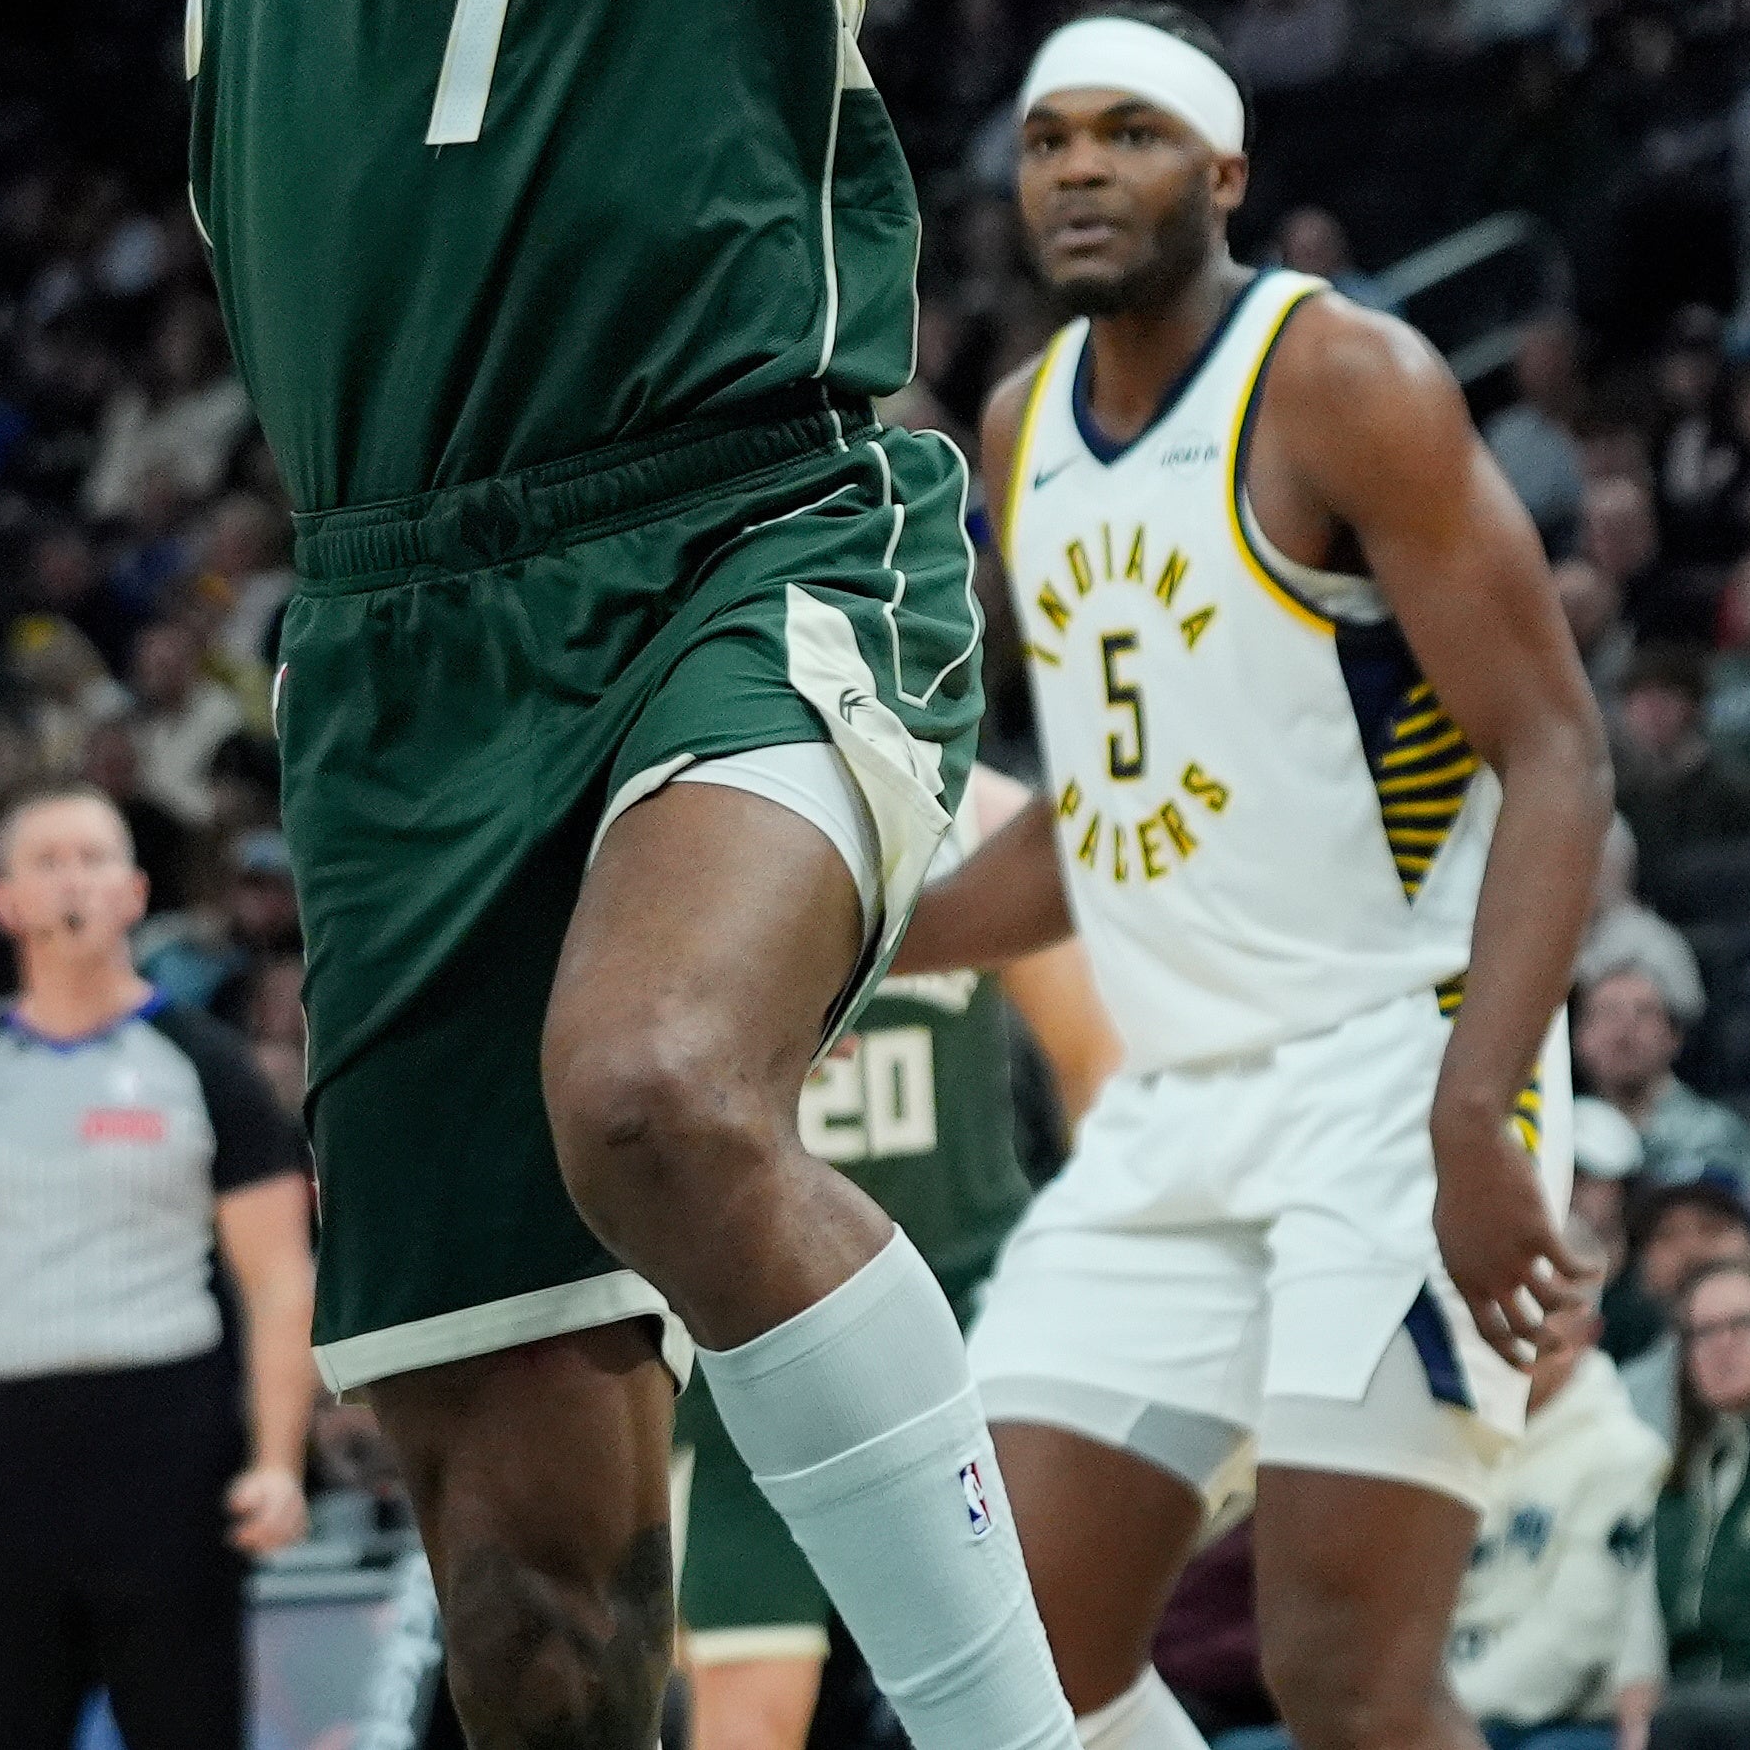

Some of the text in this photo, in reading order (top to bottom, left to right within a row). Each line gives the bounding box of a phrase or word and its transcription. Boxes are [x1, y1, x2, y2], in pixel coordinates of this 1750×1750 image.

[1023, 521, 1218, 668] INDIANA
[1099, 629, 1150, 781] 5
[799, 1025, 938, 1164] 20
